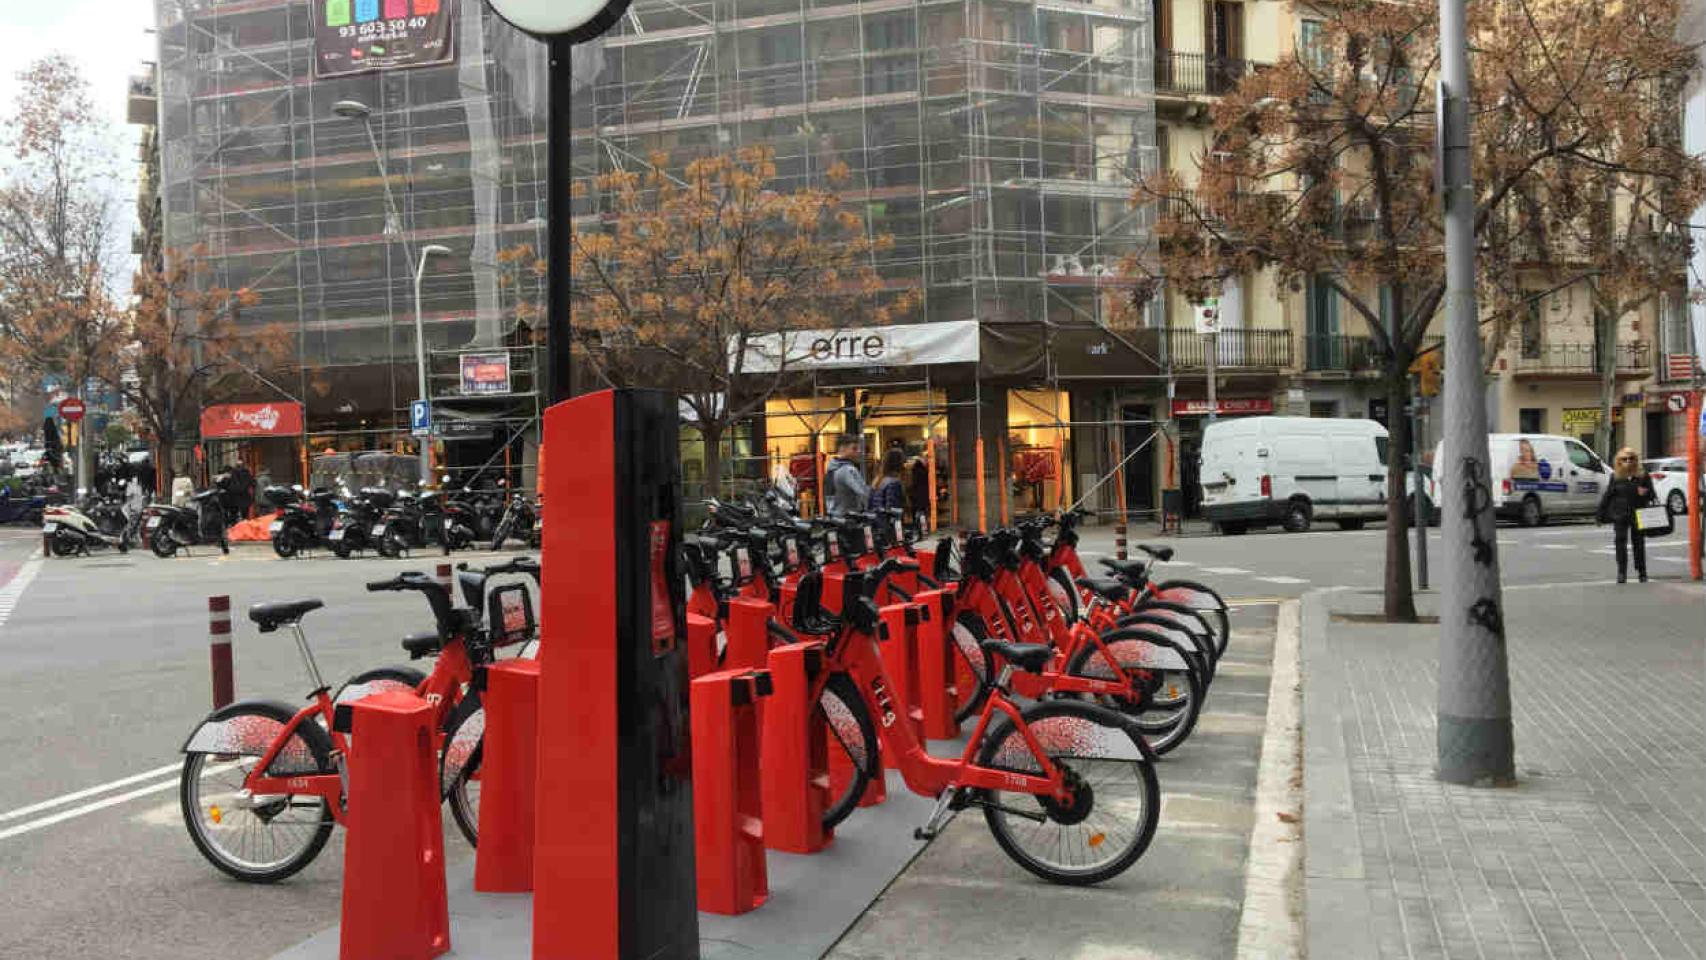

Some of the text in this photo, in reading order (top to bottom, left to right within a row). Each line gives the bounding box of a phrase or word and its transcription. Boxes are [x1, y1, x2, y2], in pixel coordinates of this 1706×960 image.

[408, 16, 427, 28] 40
[811, 335, 884, 360] erre
[414, 403, 424, 427] P
